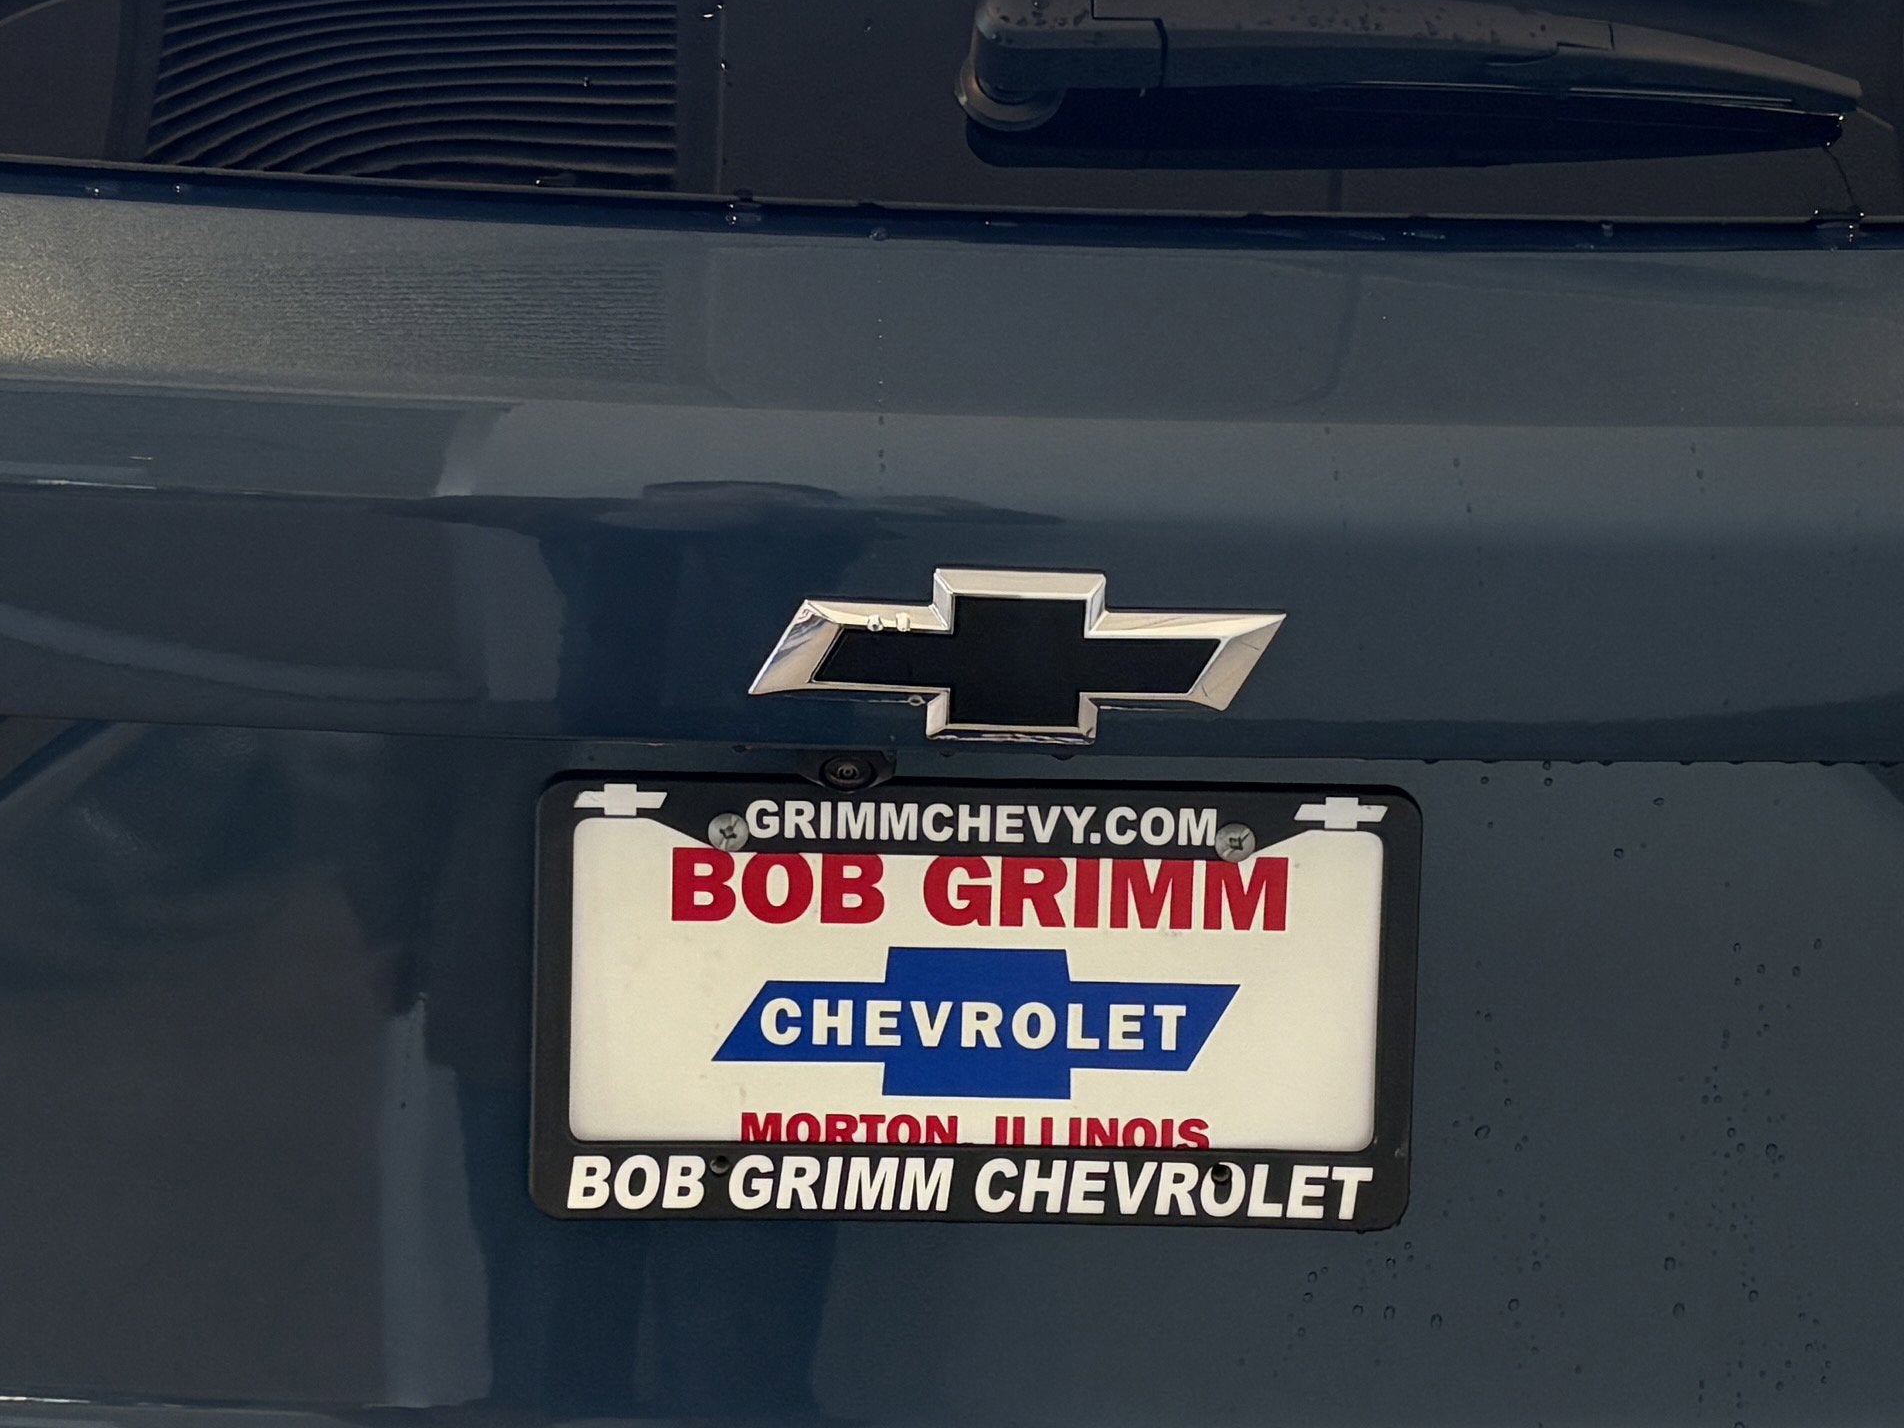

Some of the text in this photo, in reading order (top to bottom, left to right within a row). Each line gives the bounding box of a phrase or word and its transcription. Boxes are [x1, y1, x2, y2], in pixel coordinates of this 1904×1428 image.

[745, 799, 1217, 847] GRIMMCHEVY.COM
[671, 847, 1289, 932] BOB GRIMM
[760, 996, 1189, 1052] CHEVROLET
[566, 1155, 1374, 1220] BOB GRIMM CHEVROLET
